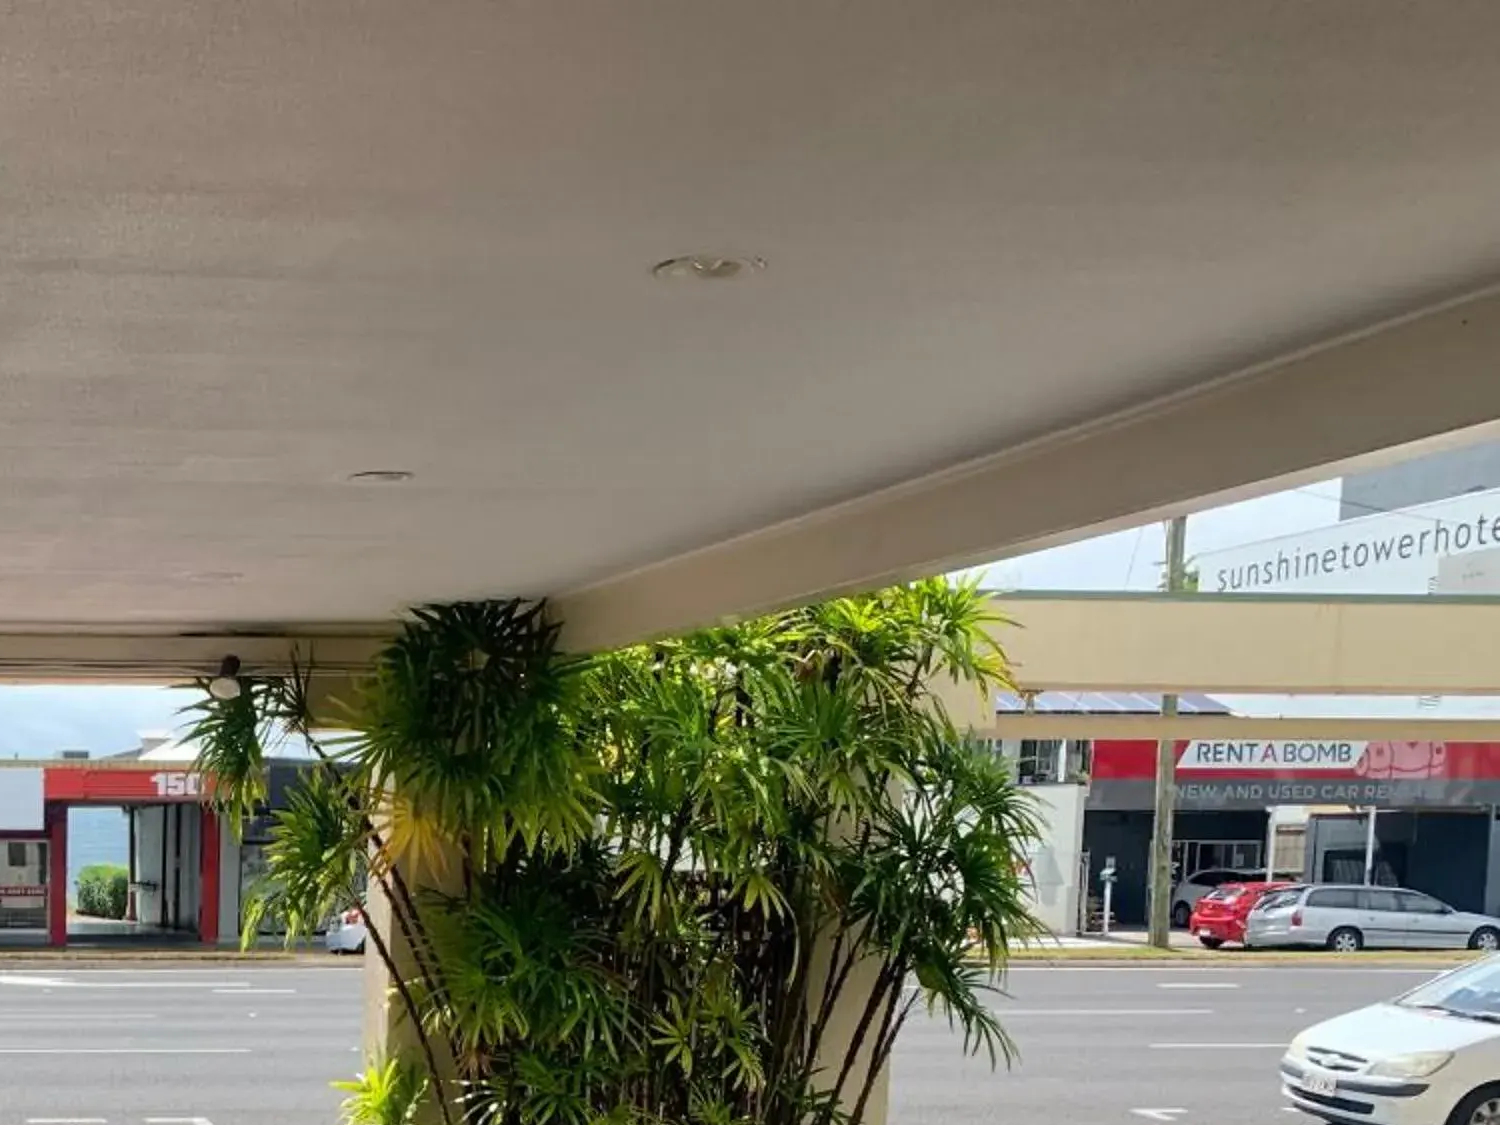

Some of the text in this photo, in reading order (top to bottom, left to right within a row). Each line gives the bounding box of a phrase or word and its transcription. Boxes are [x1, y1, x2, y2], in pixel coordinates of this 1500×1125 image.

[1197, 743, 1353, 763] RENT A BOMB
[150, 772, 200, 796] 150
[1174, 784, 1218, 799] NEW
[1224, 784, 1262, 800] AND
[1268, 784, 1316, 800] USED
[1320, 784, 1359, 800] CAR
